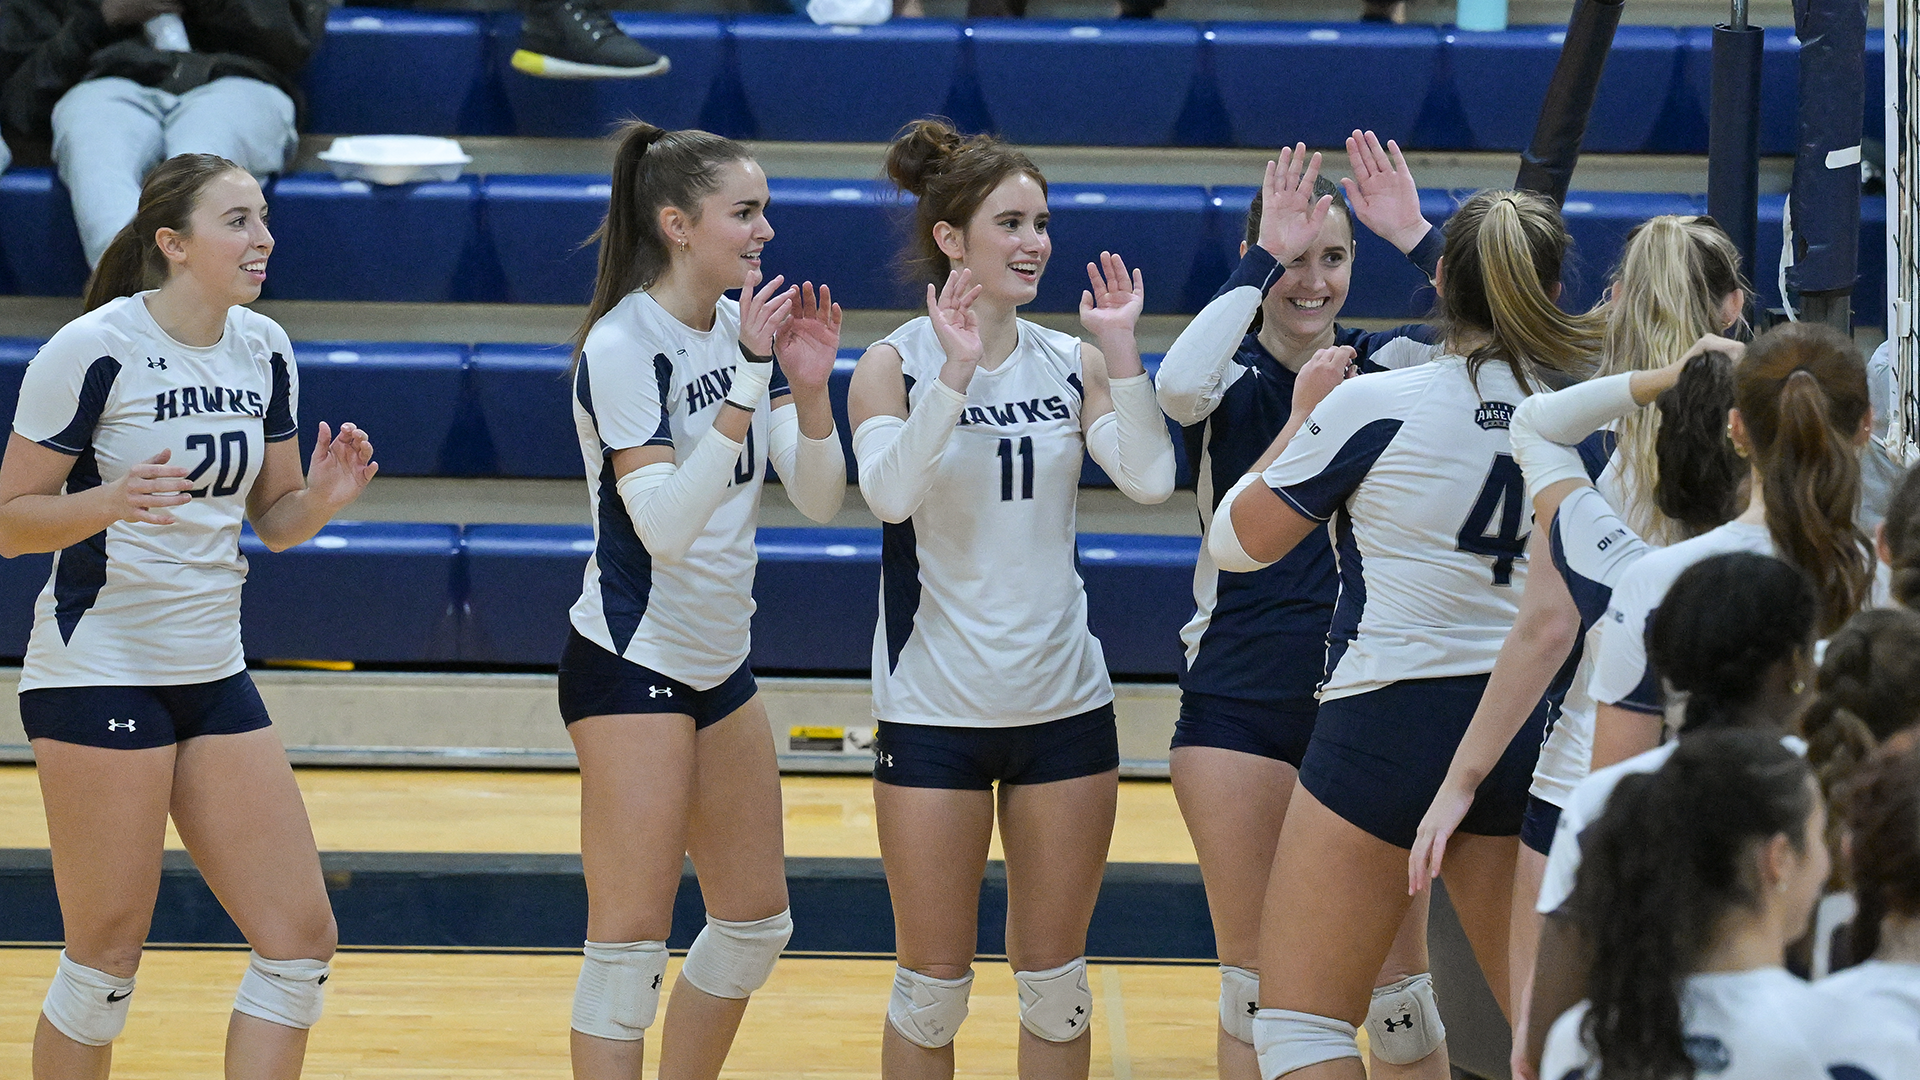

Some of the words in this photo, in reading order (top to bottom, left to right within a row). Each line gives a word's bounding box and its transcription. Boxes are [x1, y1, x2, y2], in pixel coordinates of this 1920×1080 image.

[153, 386, 264, 422] HAWKS
[686, 366, 737, 416] HAW
[1476, 410, 1511, 422] ANSEL
[180, 429, 248, 498] 20
[727, 421, 755, 487] 0
[997, 435, 1034, 501] 11
[1455, 451, 1531, 587] 4
